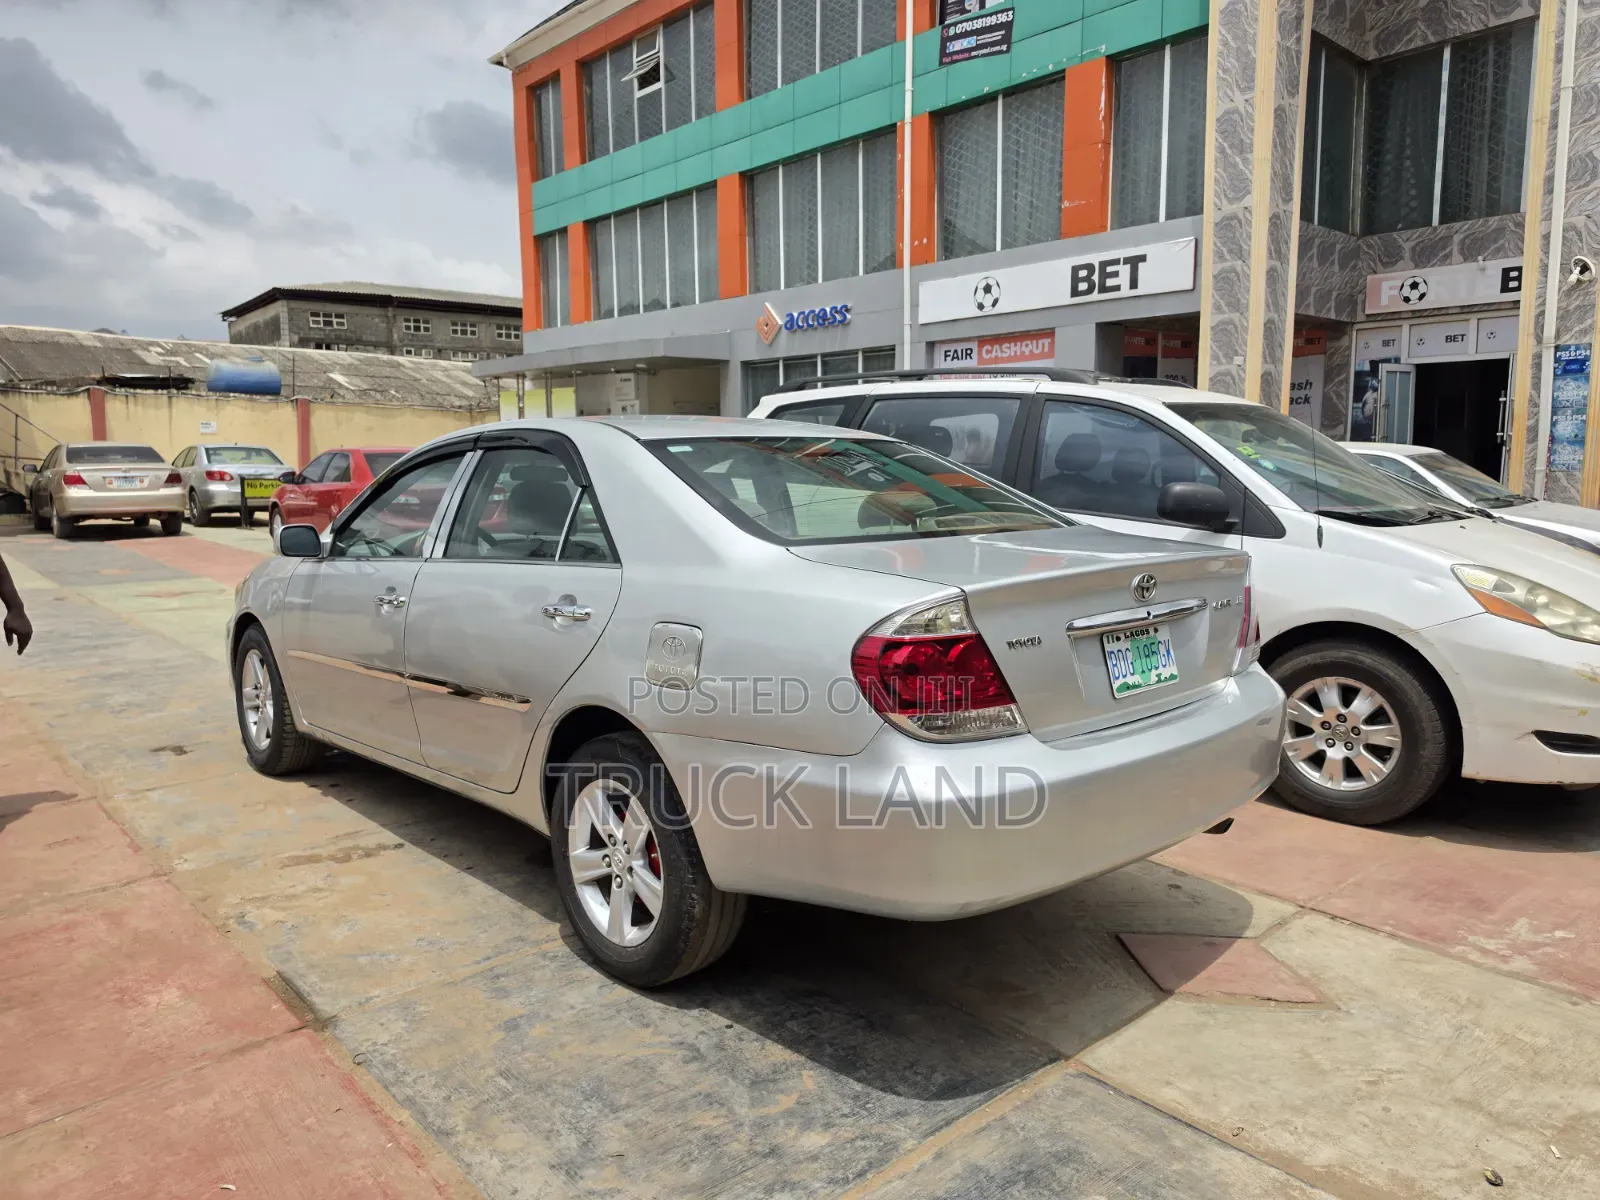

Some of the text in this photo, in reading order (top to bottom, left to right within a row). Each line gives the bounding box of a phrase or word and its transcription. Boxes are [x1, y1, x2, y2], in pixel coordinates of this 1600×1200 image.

[1070, 253, 1147, 298] BET
[784, 303, 850, 331] access
[1382, 339, 1396, 348] BET
[1445, 334, 1466, 343] BET
[943, 347, 974, 362] FAIR
[1124, 628, 1150, 640] LAGOS
[1005, 635, 1043, 651] TOYOTA
